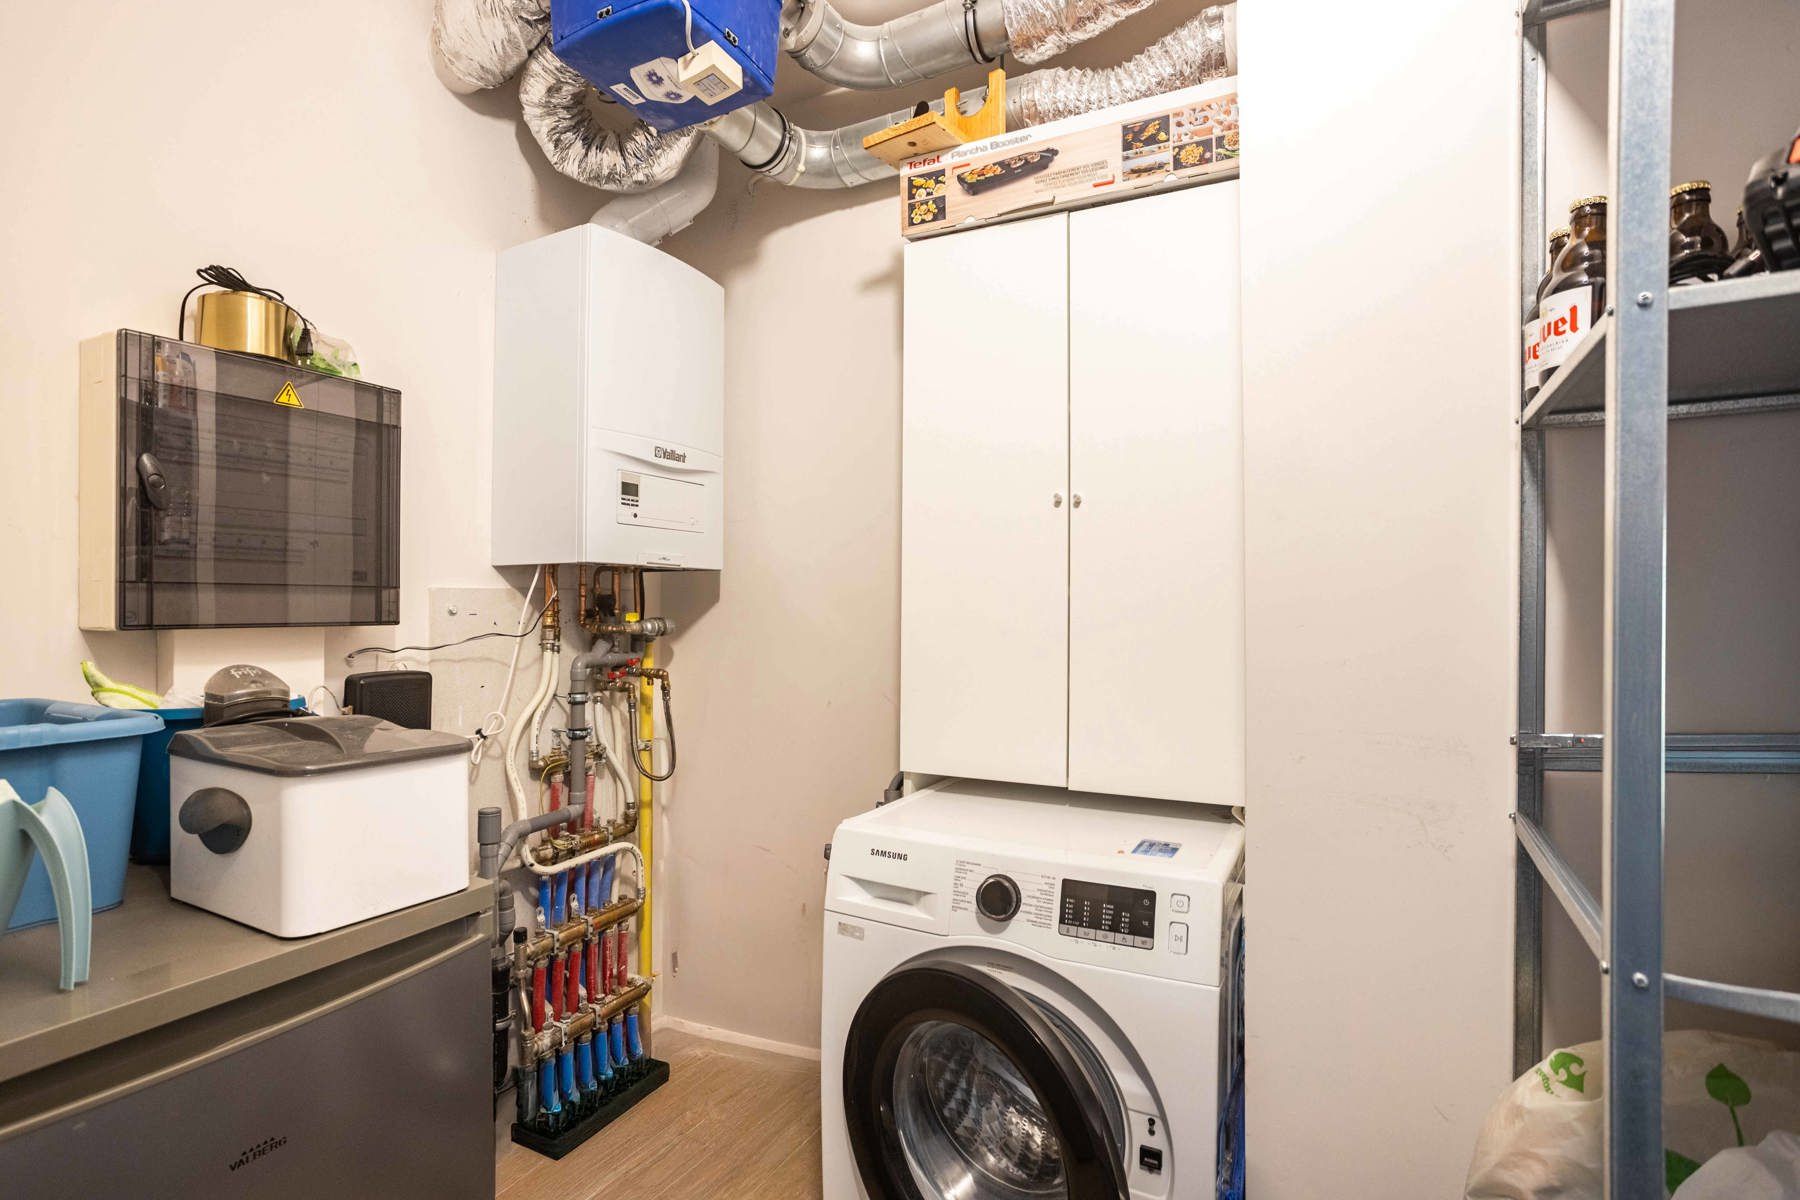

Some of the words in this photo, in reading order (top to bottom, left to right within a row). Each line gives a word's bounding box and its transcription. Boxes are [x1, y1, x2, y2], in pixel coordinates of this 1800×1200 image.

[907, 155, 942, 170] Tefal
[950, 144, 989, 160] Plancha
[990, 133, 1032, 151] Booster
[662, 448, 687, 463] Vaillant
[870, 848, 908, 861] SAMSUNG
